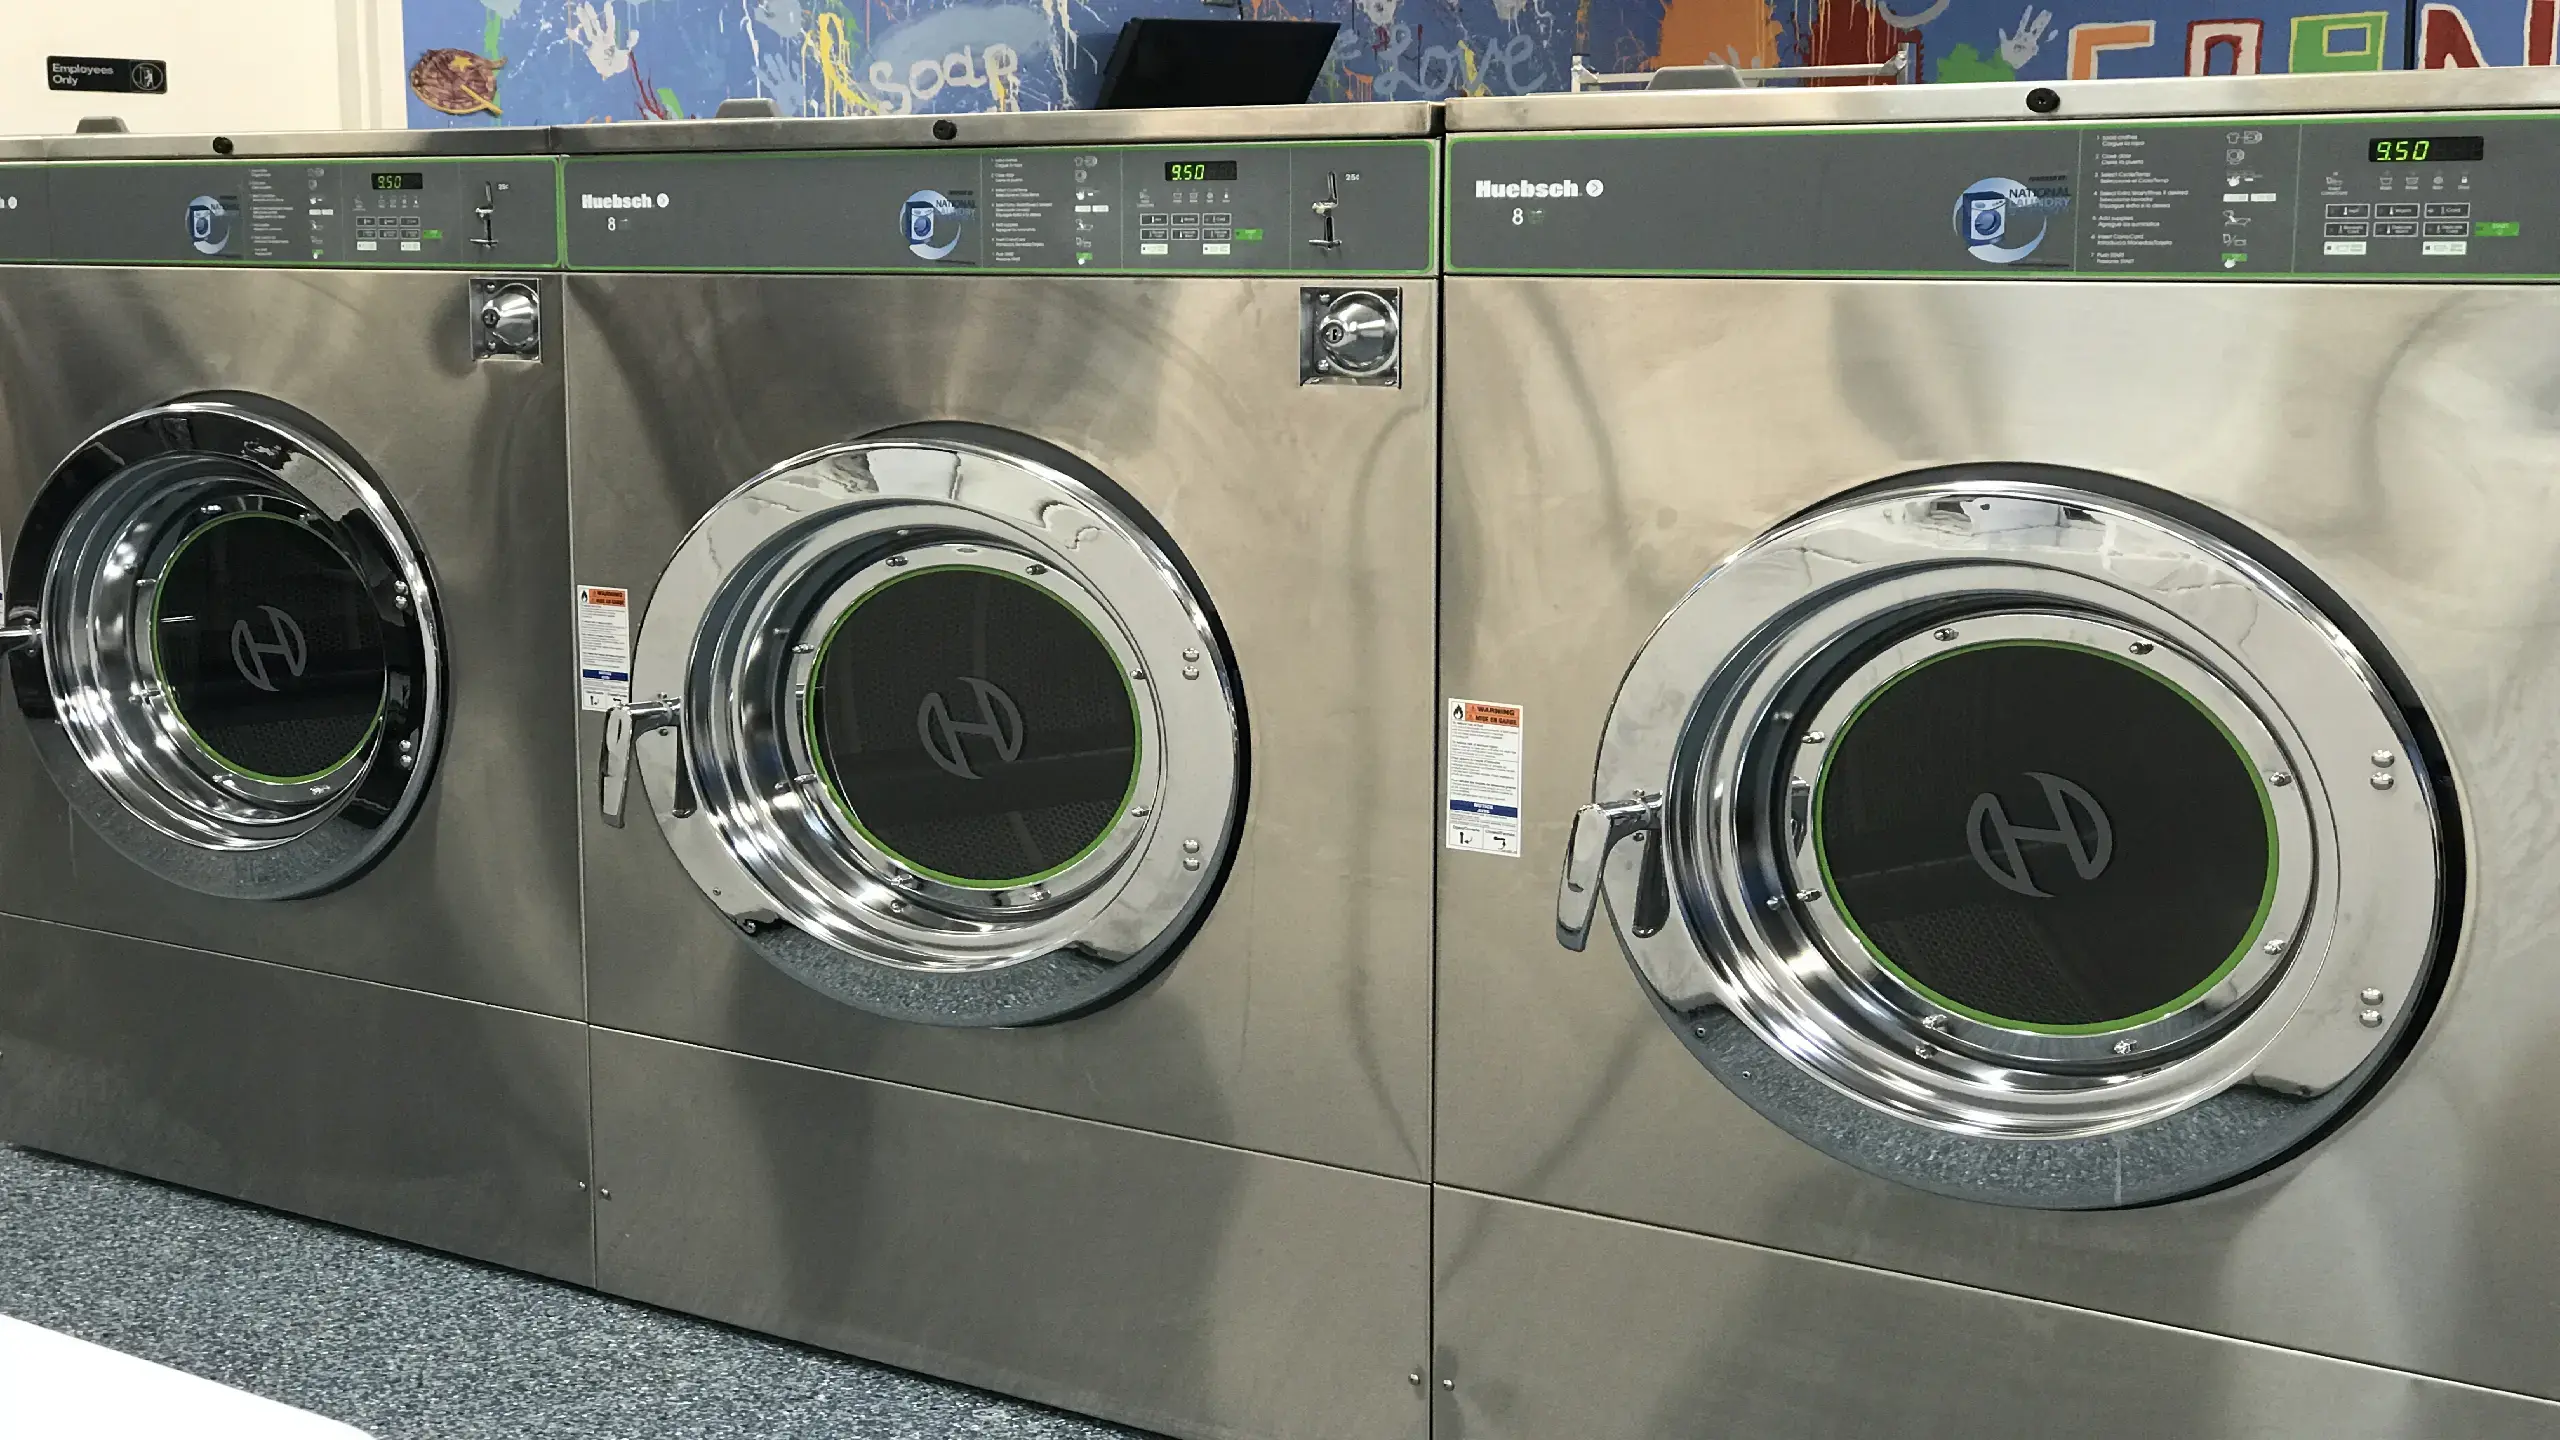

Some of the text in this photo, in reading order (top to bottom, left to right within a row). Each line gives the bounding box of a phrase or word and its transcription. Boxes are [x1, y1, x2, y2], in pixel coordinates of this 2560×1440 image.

[1373, 23, 1547, 95] Love
[52, 63, 114, 76] Employees
[52, 74, 78, 86] Only
[2376, 140, 2430, 161] 9.50
[1172, 164, 1205, 180] 9.50
[1475, 180, 1579, 198] Huebsch
[2009, 186, 2072, 198] NATIONAL
[582, 194, 652, 208] Huebsch
[2009, 197, 2070, 209] LAUNDRY
[1512, 207, 1524, 225] 8
[608, 216, 616, 231] 8
[1477, 706, 1515, 716] WARNING
